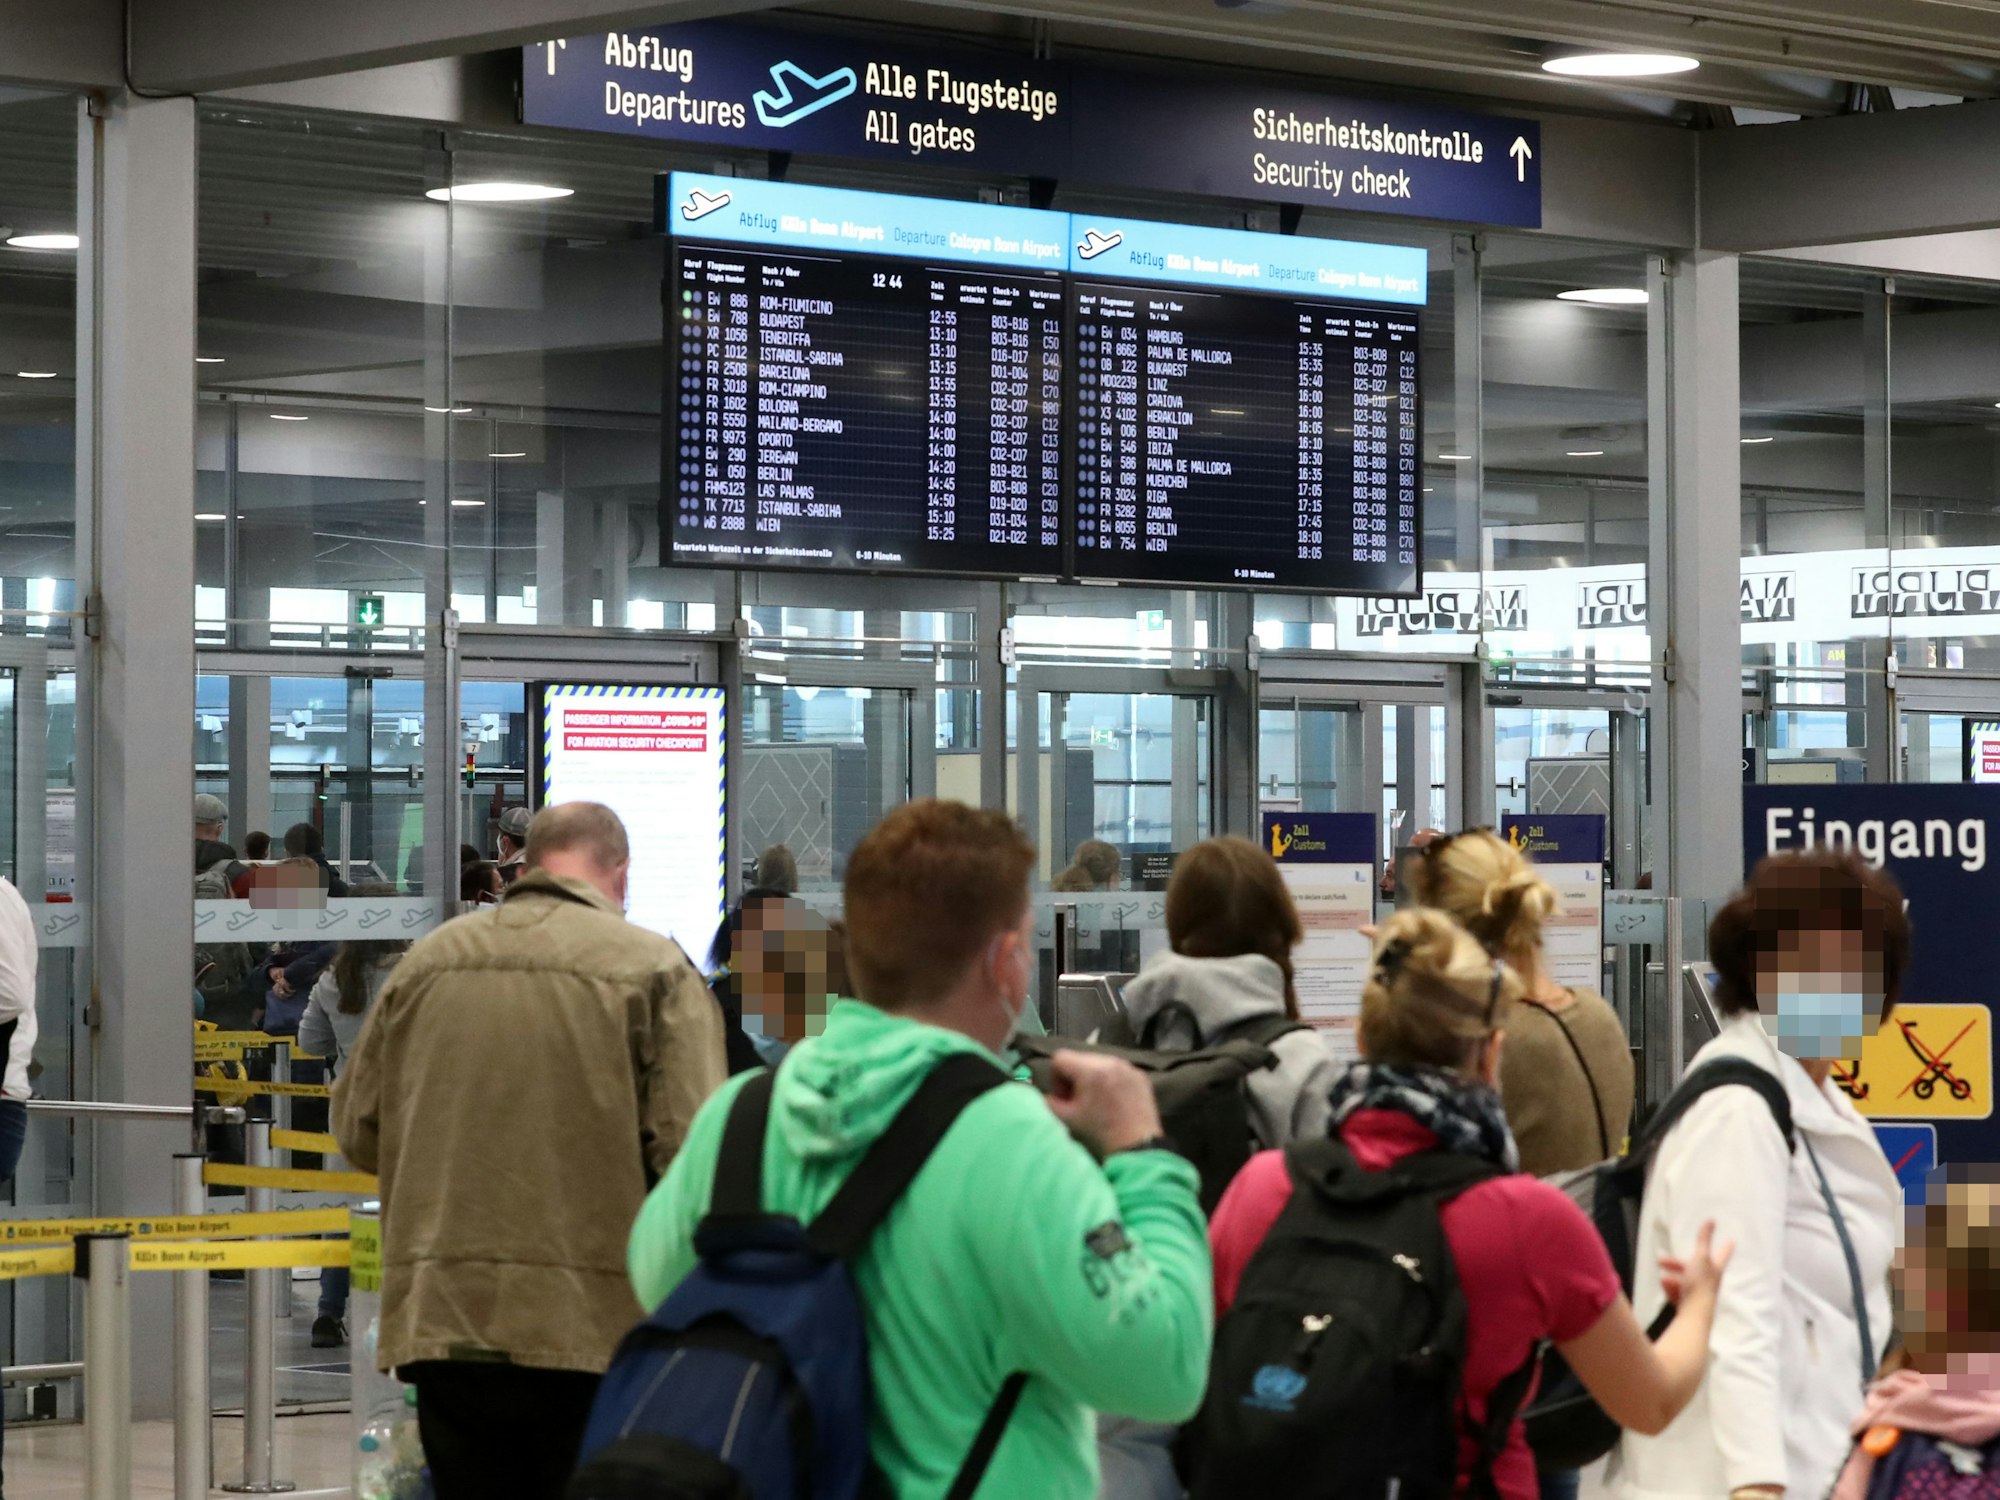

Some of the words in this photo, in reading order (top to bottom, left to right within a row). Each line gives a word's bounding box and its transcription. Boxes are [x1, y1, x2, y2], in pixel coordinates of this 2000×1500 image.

[605, 32, 693, 83] Abflug
[605, 81, 745, 129] Departures
[865, 62, 916, 99] Alle
[927, 70, 1057, 121] Flugsteige
[865, 111, 899, 145] All
[909, 123, 975, 154] gates
[1253, 108, 1483, 163] Sicherheitskontrolle
[1253, 153, 1343, 196] Security
[1352, 170, 1411, 199] check
[740, 212, 777, 232] Abflug
[841, 221, 884, 242] Airport
[895, 227, 946, 249] Departure
[949, 232, 991, 253] Cologne
[1022, 238, 1061, 258] Airport
[873, 273, 886, 288] 12
[889, 275, 903, 289] 44
[1130, 251, 1164, 270] Abflug
[1221, 258, 1260, 278] Airport
[1269, 264, 1315, 282] Departure
[1318, 268, 1355, 289] Cologne
[1384, 274, 1418, 292] Airport
[707, 291, 720, 305] EW
[730, 293, 748, 308] 886
[759, 295, 833, 315] ROM-FIUMICINO
[929, 309, 957, 325] 12:55
[707, 308, 720, 322] EW
[730, 310, 748, 325] 788
[759, 312, 805, 329] BUDAPEST
[929, 326, 956, 342] 13:10
[707, 325, 719, 339] XR
[725, 327, 747, 342] 1056
[759, 329, 810, 347] TENERIFFA
[929, 342, 956, 358] 13:10
[1147, 329, 1183, 344] HAMBURG
[1298, 341, 1323, 356] 15:35
[707, 342, 719, 357] PC
[724, 344, 747, 359] 1012
[760, 346, 843, 366] ISTANBUL-SABIHA
[929, 359, 956, 375] 13:15
[1147, 345, 1173, 360] PALMA
[1177, 347, 1187, 361] DE
[1191, 348, 1231, 364] MALLORCA
[1298, 357, 1322, 372] 15:35
[706, 359, 719, 373] FR
[723, 361, 747, 376] 2508
[759, 363, 810, 381] BARCELONA
[929, 375, 956, 391] 13:55
[1147, 361, 1187, 377] BUKAREST
[1298, 373, 1323, 387] 15:40
[706, 376, 718, 391] FR
[723, 378, 747, 393] 3018
[758, 380, 826, 399] ROM-CIAMPINO
[929, 392, 956, 408] 13:55
[1147, 377, 1167, 391] LINZ
[1298, 388, 1322, 403] 16:00
[706, 394, 718, 408] FR
[724, 395, 746, 410] 1602
[758, 398, 798, 414] BOLOGNA
[929, 409, 956, 425] 14:00
[1147, 393, 1183, 408] CRAIOVA
[1298, 404, 1322, 419] 16:00
[706, 411, 718, 425] FR
[722, 412, 746, 427] 5550
[757, 414, 842, 433] MAILAND-BERGAMO
[928, 425, 956, 441] 14:00
[1146, 409, 1193, 425] HERAKLION
[1298, 420, 1322, 434] 16:05
[705, 428, 718, 442] FR
[722, 429, 746, 444] 9973
[757, 431, 793, 447] OPORTO
[928, 442, 955, 457] 14:00
[1146, 425, 1178, 440] BERLIN
[1298, 435, 1322, 450] 16:10
[705, 445, 718, 460] EW
[727, 447, 746, 461] 290
[758, 448, 798, 465] JEREWAN
[928, 459, 955, 474] 14:20
[1147, 441, 1173, 455] IBIZA
[1298, 451, 1322, 465] 16:30
[705, 462, 718, 477] EW
[727, 464, 745, 479] 050
[757, 466, 792, 481] BERLIN
[928, 475, 955, 491] 14:45
[1146, 457, 1173, 472] PALMA
[1176, 459, 1187, 472] DE
[1190, 460, 1231, 475] MALLORCA
[1298, 466, 1322, 481] 16:35
[704, 480, 745, 496] FHM5123
[757, 483, 775, 497] LAS
[780, 484, 814, 500] PALMAS
[928, 492, 955, 507] 14:50
[1146, 473, 1187, 488] MUENCHEN
[1298, 482, 1322, 497] 17:05
[704, 497, 717, 511] TK
[721, 498, 745, 513] 7713
[757, 500, 841, 518] ISTANBUL-SABIHA
[927, 509, 955, 524] 15:10
[1146, 489, 1167, 503] RIGA
[1298, 498, 1322, 512] 17:15
[703, 514, 716, 529] W6
[721, 515, 745, 530] 2888
[756, 517, 780, 532] WIEN
[927, 525, 954, 540] 15:25
[1146, 505, 1172, 520] ZADAR
[1297, 513, 1322, 528] 17:45
[1146, 521, 1177, 536] BERLIN
[1298, 530, 1322, 544] 18:00
[1145, 537, 1167, 551] WIEN
[1297, 545, 1322, 559] 18:05
[1293, 824, 1309, 836] Zoll
[1529, 826, 1544, 837] Zoll
[1766, 807, 1986, 872] Eingang
[1293, 840, 1326, 850] Customs
[1528, 841, 1559, 851] Customs
[155, 1223, 174, 1233] Köln
[176, 1222, 196, 1233] Bonn
[200, 1221, 230, 1233] Airport
[135, 1251, 158, 1262] Köln
[162, 1251, 185, 1262] Bonn
[189, 1250, 225, 1263] Airport
